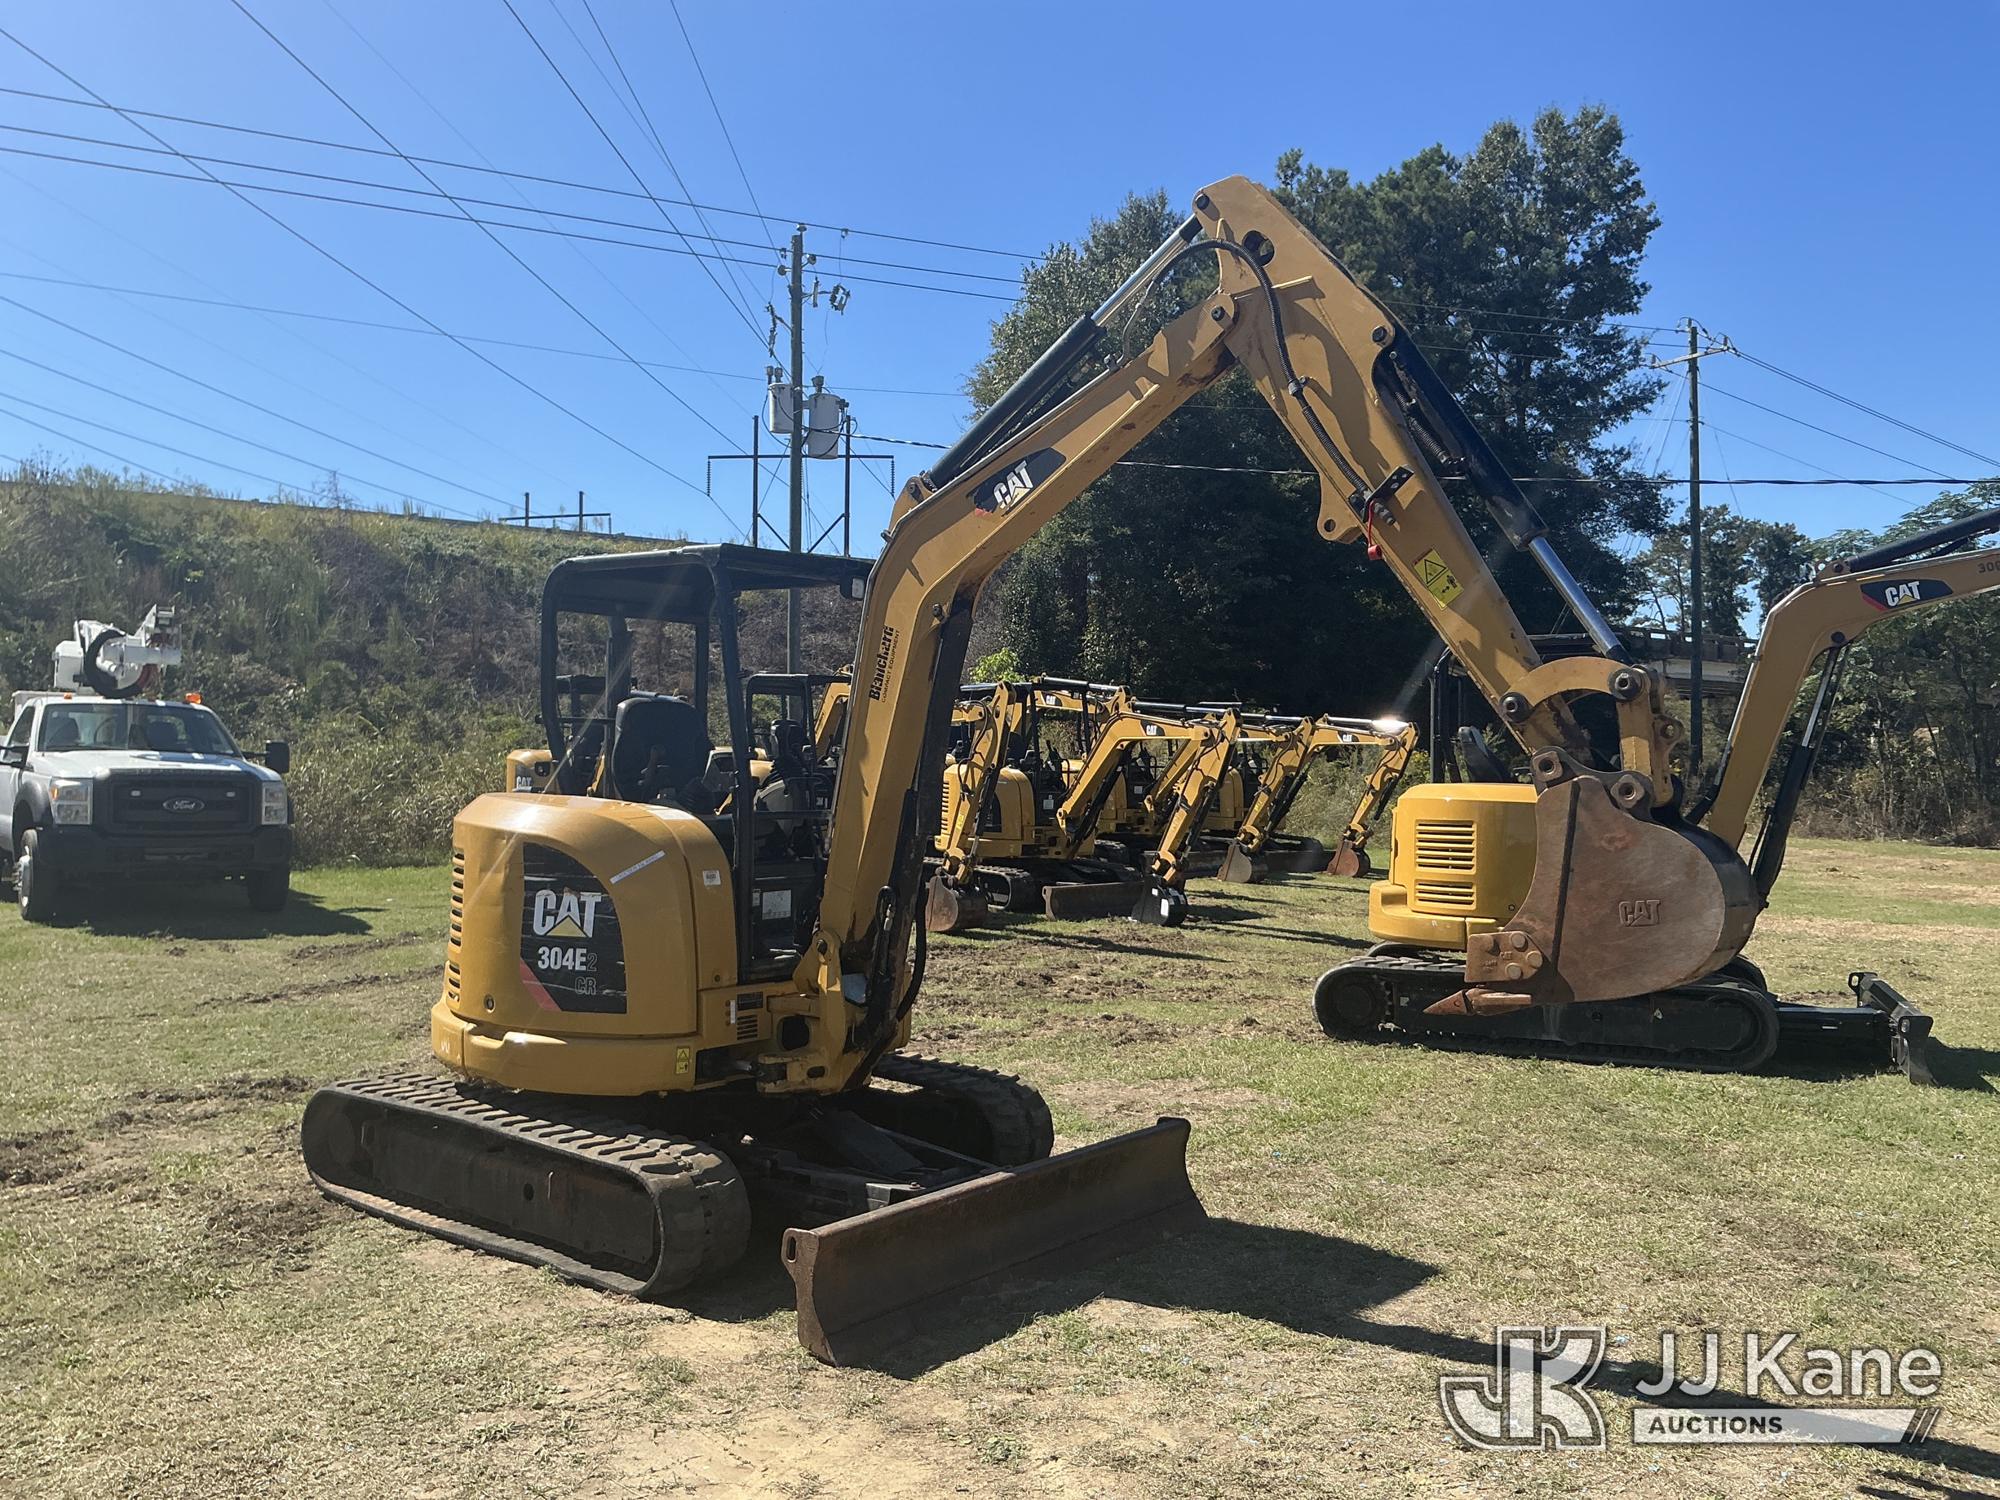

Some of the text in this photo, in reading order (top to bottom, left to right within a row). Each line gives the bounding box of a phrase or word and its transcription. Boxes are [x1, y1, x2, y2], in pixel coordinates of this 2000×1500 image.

[993, 460, 1033, 509] CAT
[1885, 581, 1920, 606] CAT
[1146, 725, 1157, 735] CAT
[173, 800, 196, 810] Ford
[533, 888, 602, 938] CAT
[1619, 899, 1661, 927] CAT
[537, 946, 598, 971] 304E2
[575, 976, 597, 995] CR
